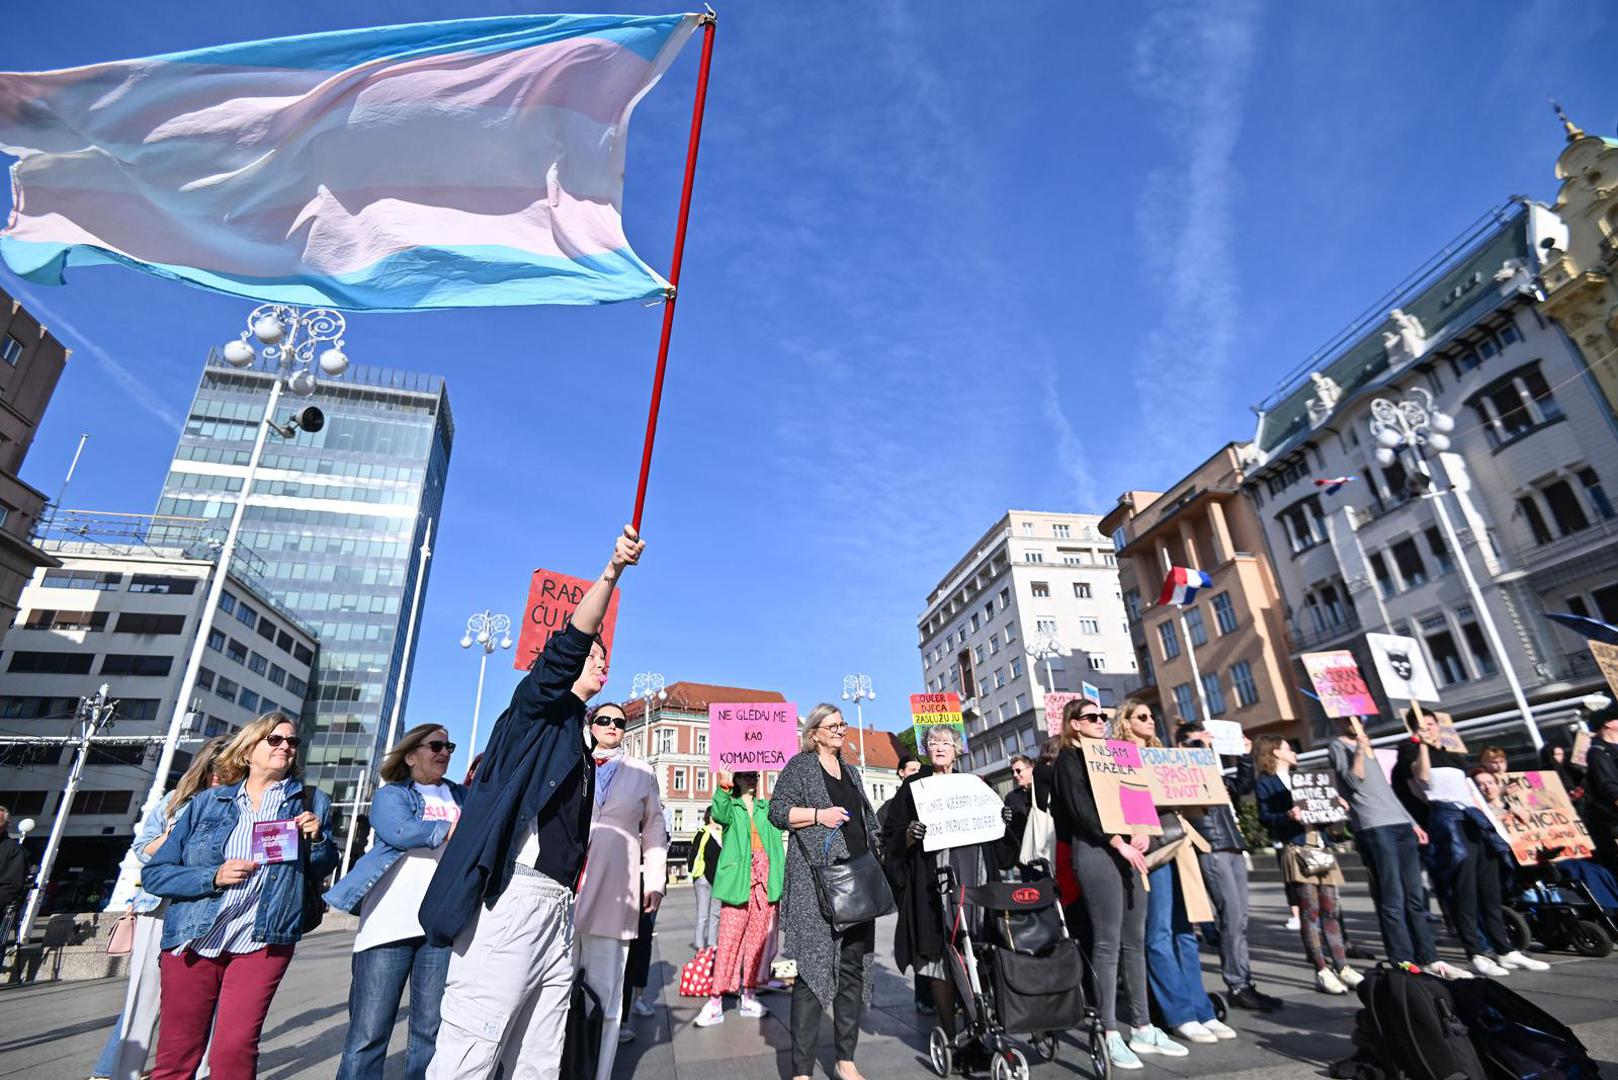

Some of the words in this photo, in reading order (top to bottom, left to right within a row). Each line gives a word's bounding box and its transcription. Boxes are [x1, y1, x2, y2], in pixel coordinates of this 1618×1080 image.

[532, 601, 558, 627] ĆU
[920, 694, 946, 703] QUEER
[921, 704, 948, 713] DJECA
[718, 710, 732, 721] NE
[736, 709, 770, 721] GLEDAJ
[773, 711, 787, 722] ME
[745, 731, 763, 741] KAO
[1092, 744, 1129, 758] NISAM
[1153, 765, 1207, 784] SPASITI
